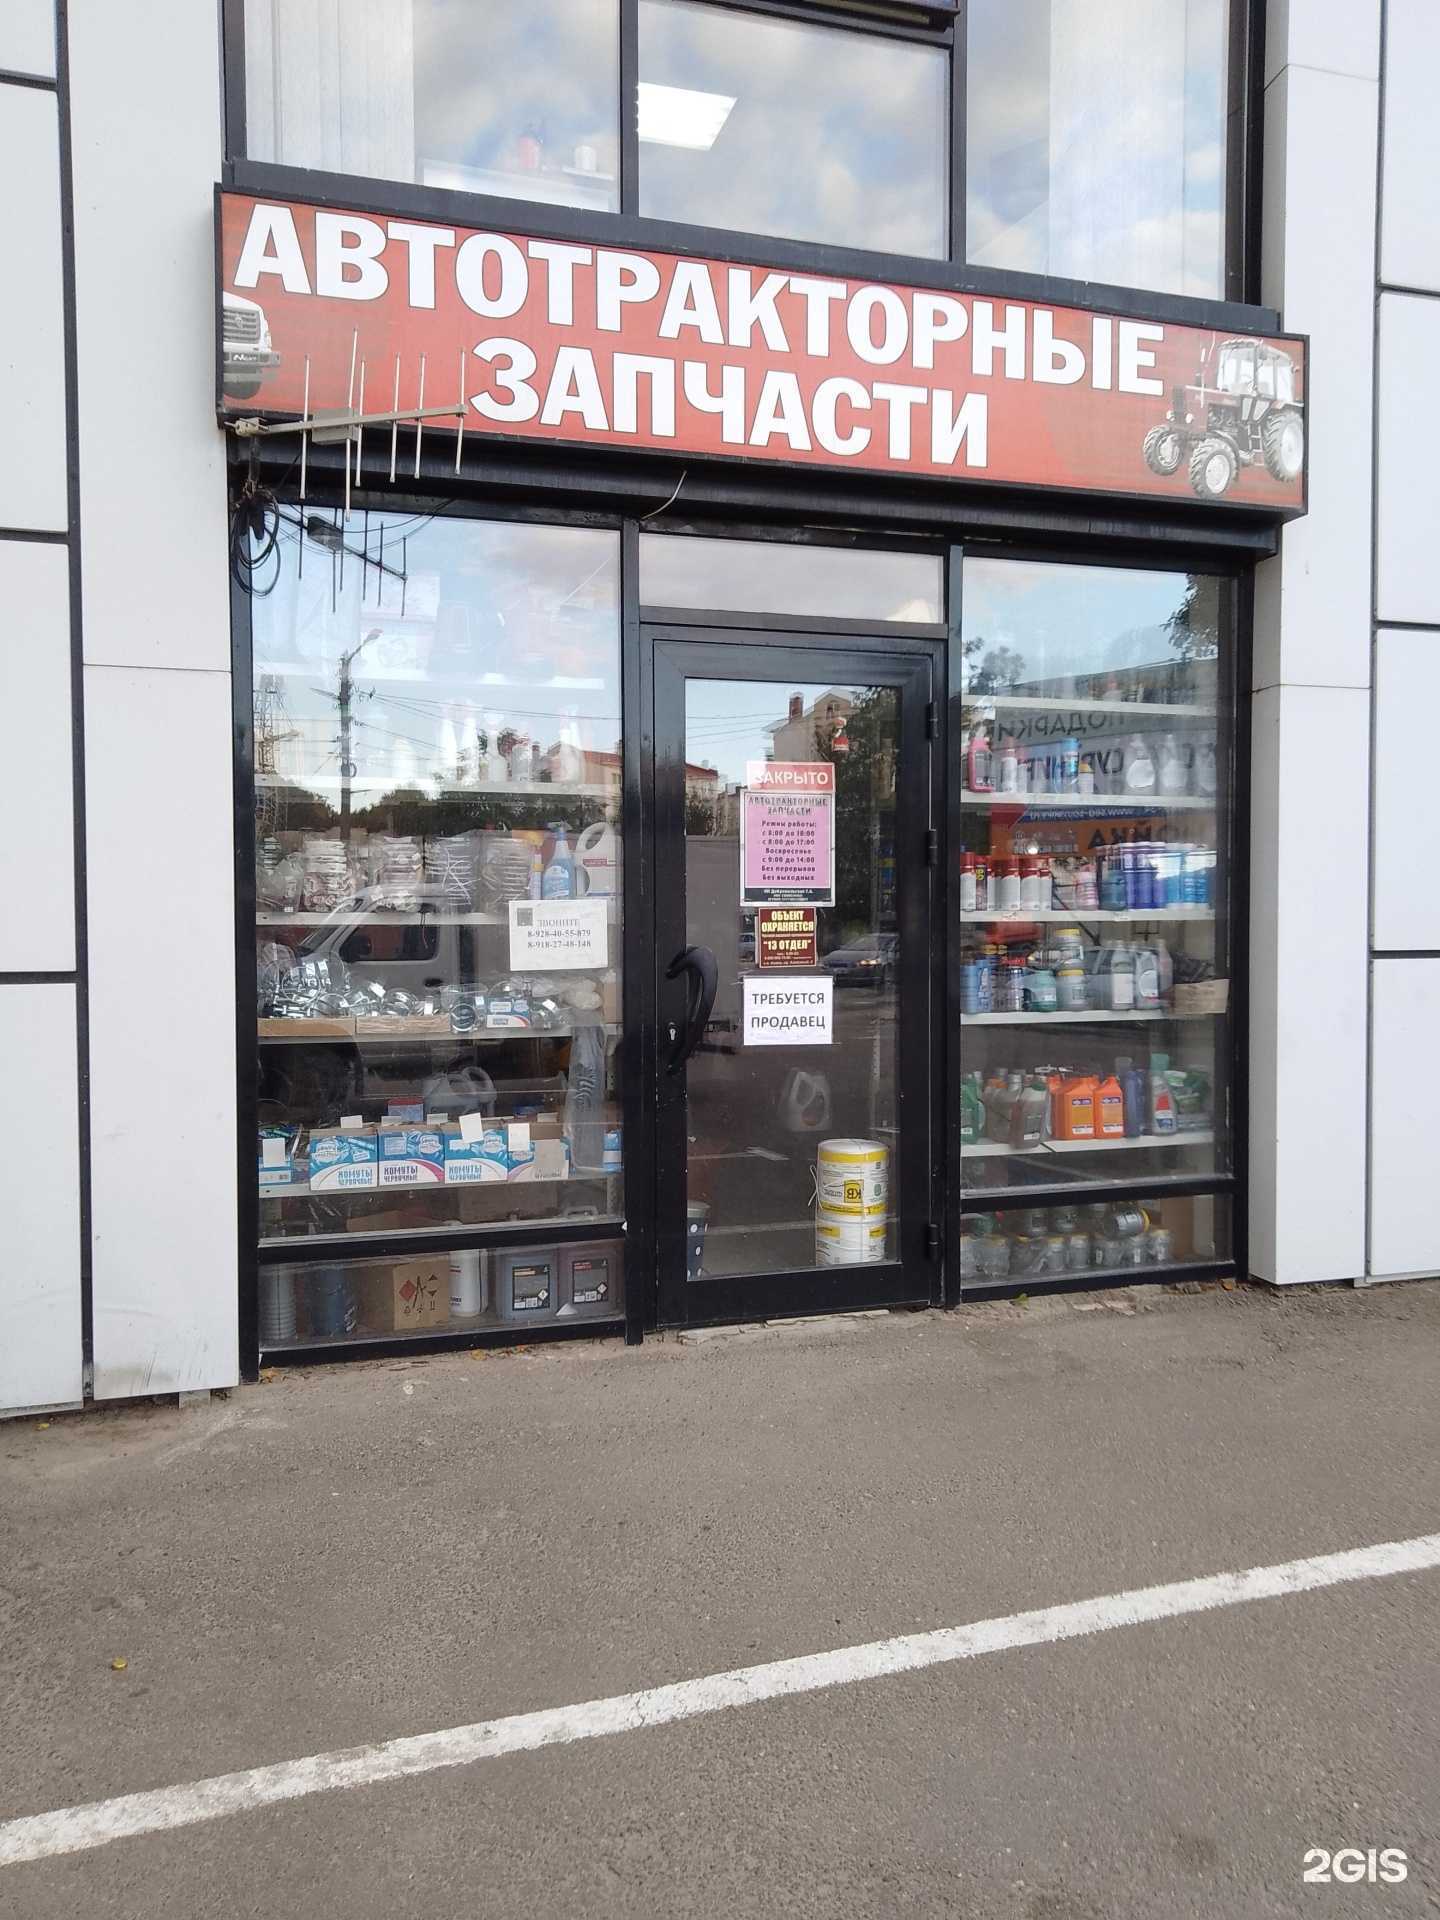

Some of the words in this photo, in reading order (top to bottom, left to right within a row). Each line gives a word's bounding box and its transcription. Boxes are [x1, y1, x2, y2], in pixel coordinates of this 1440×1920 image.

[233, 203, 1164, 396] АВТОТРАКТОРНЫЕ
[469, 337, 989, 468] ЗАПЧАСТИ
[768, 806, 811, 816] ЗАПЧАСТИ
[771, 910, 804, 921] ОБЪЕКТ
[761, 921, 814, 932] ОХРАНЯЕТСЯ
[752, 992, 825, 1005] ТРЕБУЕТСЯ
[751, 1015, 826, 1030] ПРОДАВЕЦ
